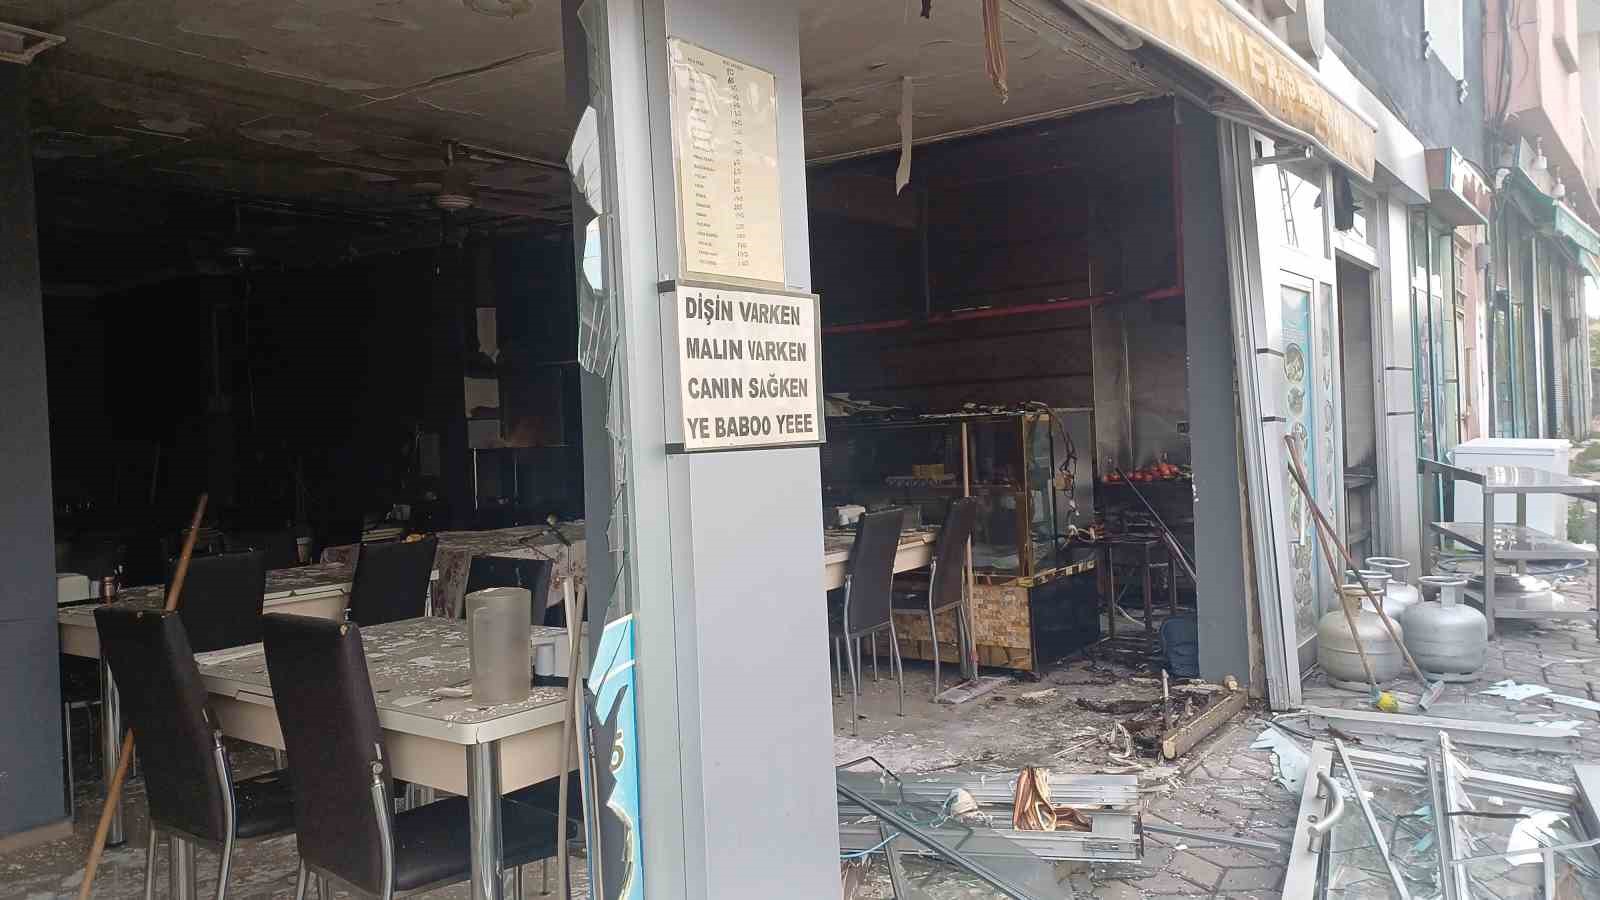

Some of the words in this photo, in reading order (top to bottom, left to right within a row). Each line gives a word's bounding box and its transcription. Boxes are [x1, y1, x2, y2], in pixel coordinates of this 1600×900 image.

[685, 292, 733, 326] DİŞİN
[739, 301, 800, 326] VARKEN
[686, 337, 743, 361] MALIN
[748, 340, 807, 362] VARKEN
[688, 377, 744, 399] CANIN
[748, 372, 808, 398] SAĞKEN
[687, 417, 710, 440] YE
[715, 415, 771, 438] BABOO
[776, 413, 813, 434] YEEE
